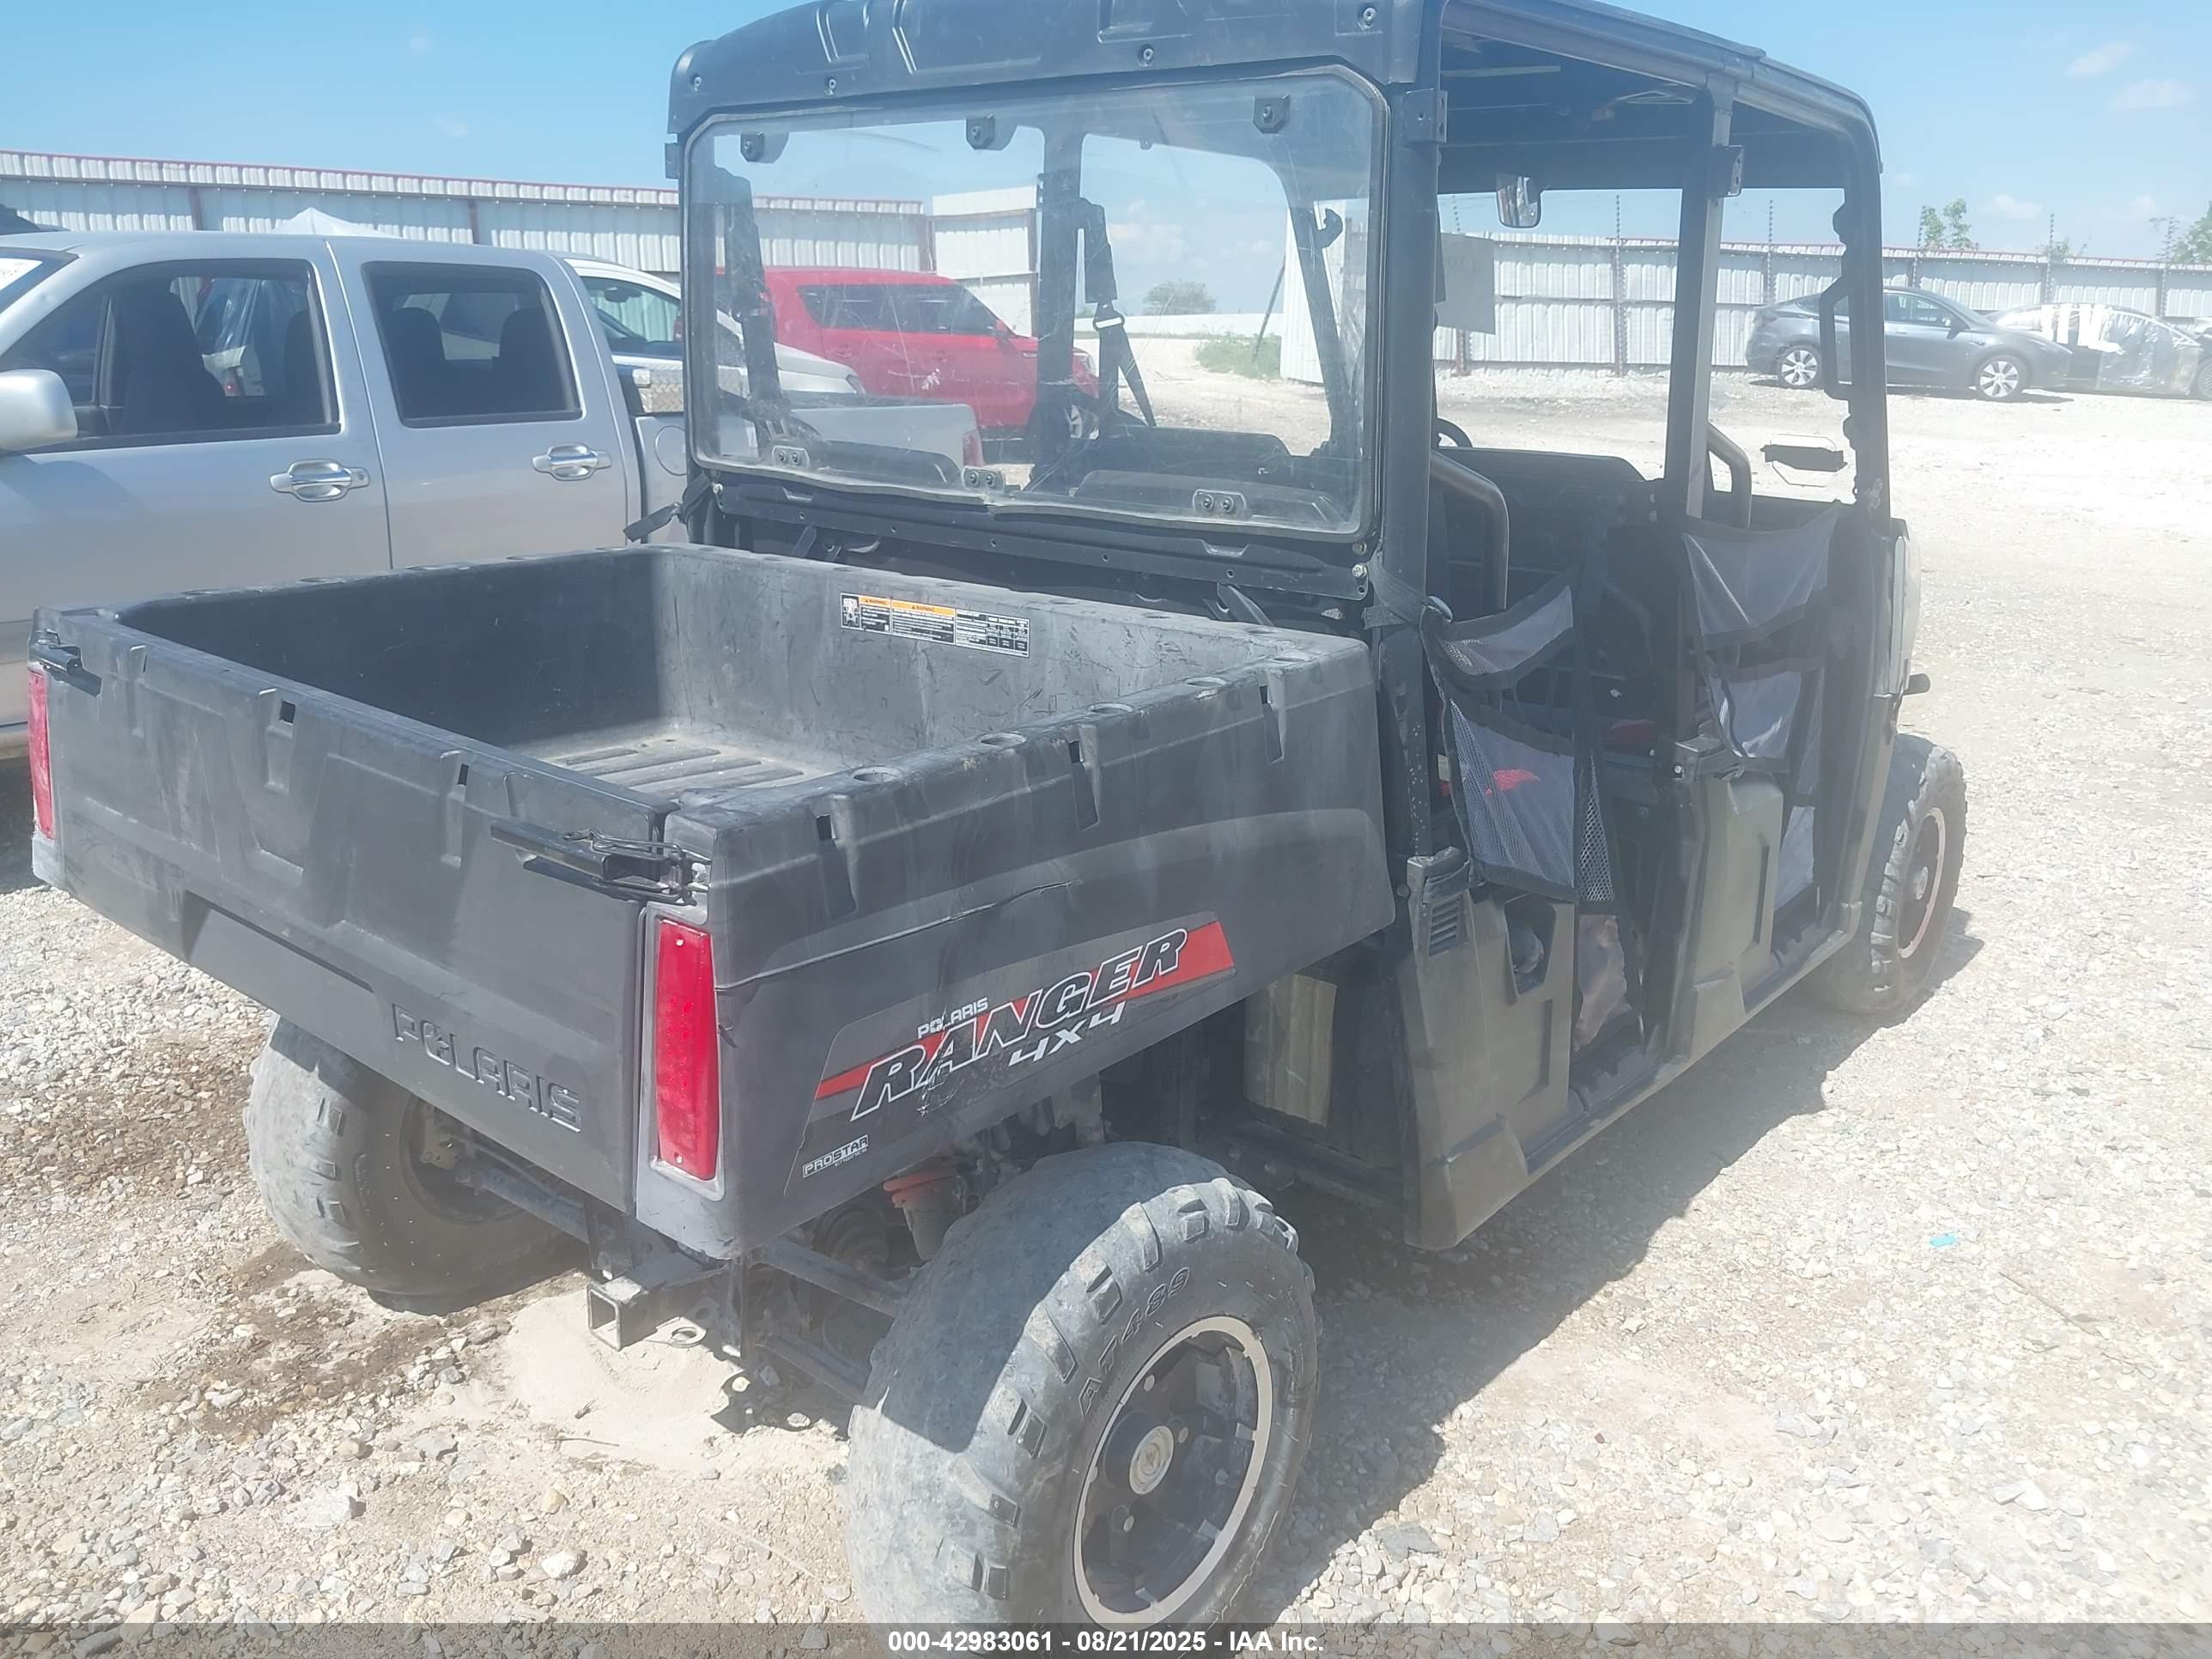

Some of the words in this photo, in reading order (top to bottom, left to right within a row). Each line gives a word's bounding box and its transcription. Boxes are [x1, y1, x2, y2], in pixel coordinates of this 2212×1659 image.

[850, 927, 1188, 1121] RANGER
[917, 996, 989, 1040] POLARIS
[392, 1003, 583, 1133] POLARIS
[804, 1136, 868, 1176] PROSTAR
